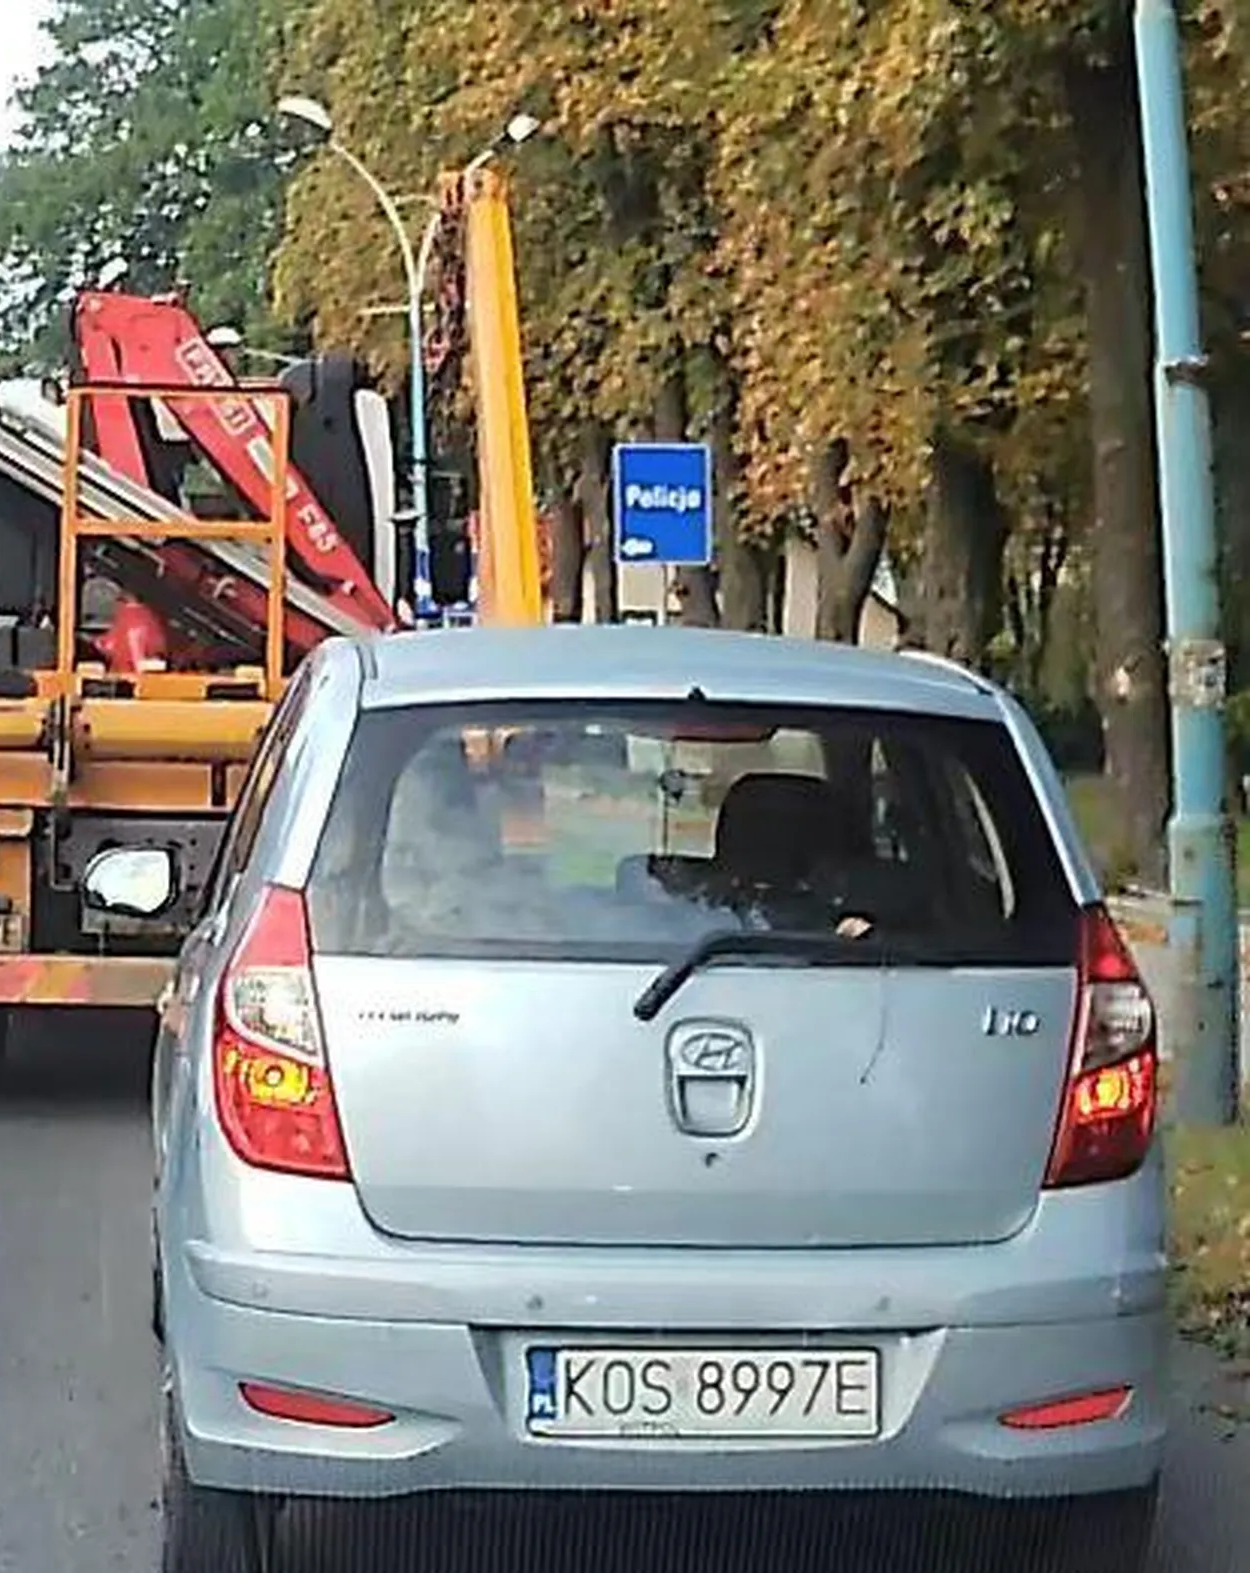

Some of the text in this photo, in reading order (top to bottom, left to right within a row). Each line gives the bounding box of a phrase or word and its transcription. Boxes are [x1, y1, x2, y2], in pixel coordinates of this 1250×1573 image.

[625, 484, 701, 513] Policja
[564, 1359, 868, 1416] KOS 8997E
